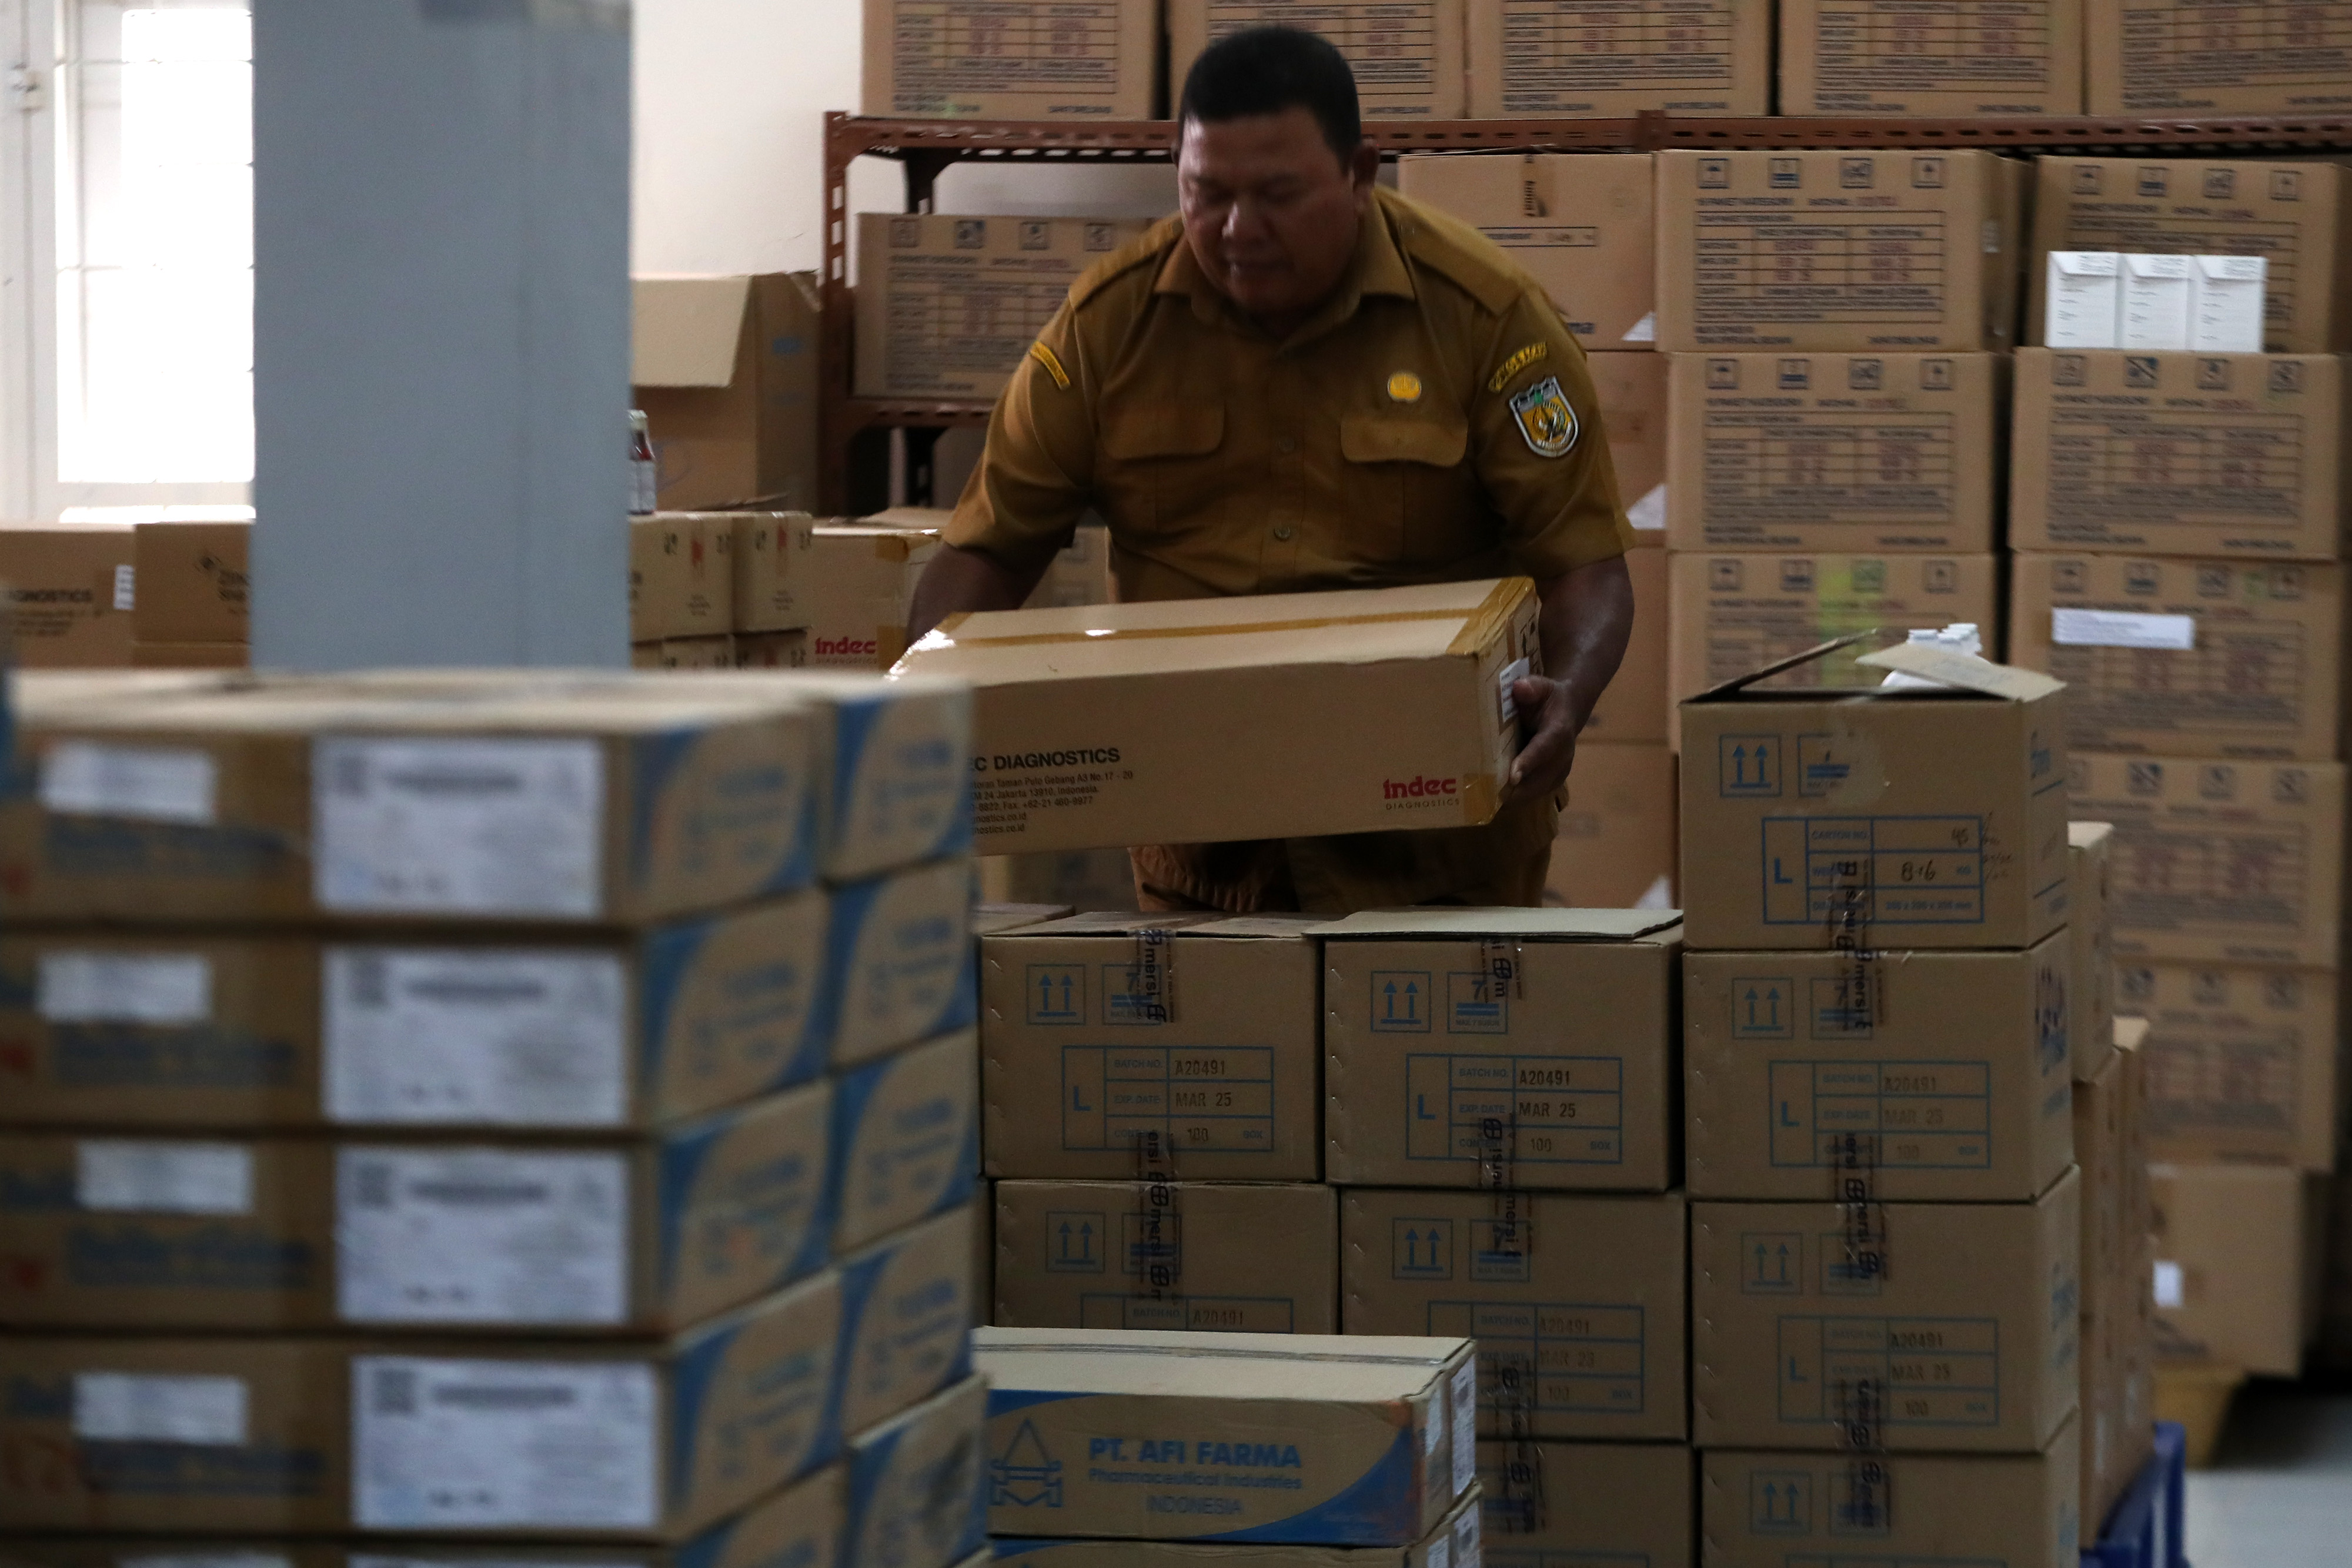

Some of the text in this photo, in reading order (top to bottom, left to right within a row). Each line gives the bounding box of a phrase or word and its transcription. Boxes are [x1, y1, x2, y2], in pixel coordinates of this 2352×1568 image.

[815, 637, 876, 654] indec
[994, 747, 1121, 771] DIAGNOSTICS
[996, 790, 1027, 799] Jakarta
[1382, 775, 1457, 800] indec
[1385, 797, 1460, 811] DIAGNOSTICS
[1773, 857, 1793, 884] L
[1144, 947, 1161, 996] mersi
[1471, 979, 1487, 1001] 7
[1114, 1059, 1145, 1068] BATCH
[1175, 1059, 1225, 1075] A20491
[1459, 1068, 1491, 1077] BATCH
[1519, 1069, 1571, 1086] A20491
[1073, 1086, 1091, 1111] L
[1176, 1091, 1232, 1107] MAR 25
[1417, 1094, 1436, 1120] L
[1481, 1105, 1505, 1114] DATE
[1518, 1102, 1576, 1118] MAR 25
[1781, 1102, 1799, 1127] L
[1530, 1137, 1552, 1152] 100
[1590, 1141, 1611, 1151] BOX
[1193, 1309, 1244, 1325] A20491
[1790, 1357, 1809, 1382] L
[1090, 1437, 1301, 1468] PT. AFI FARMA
